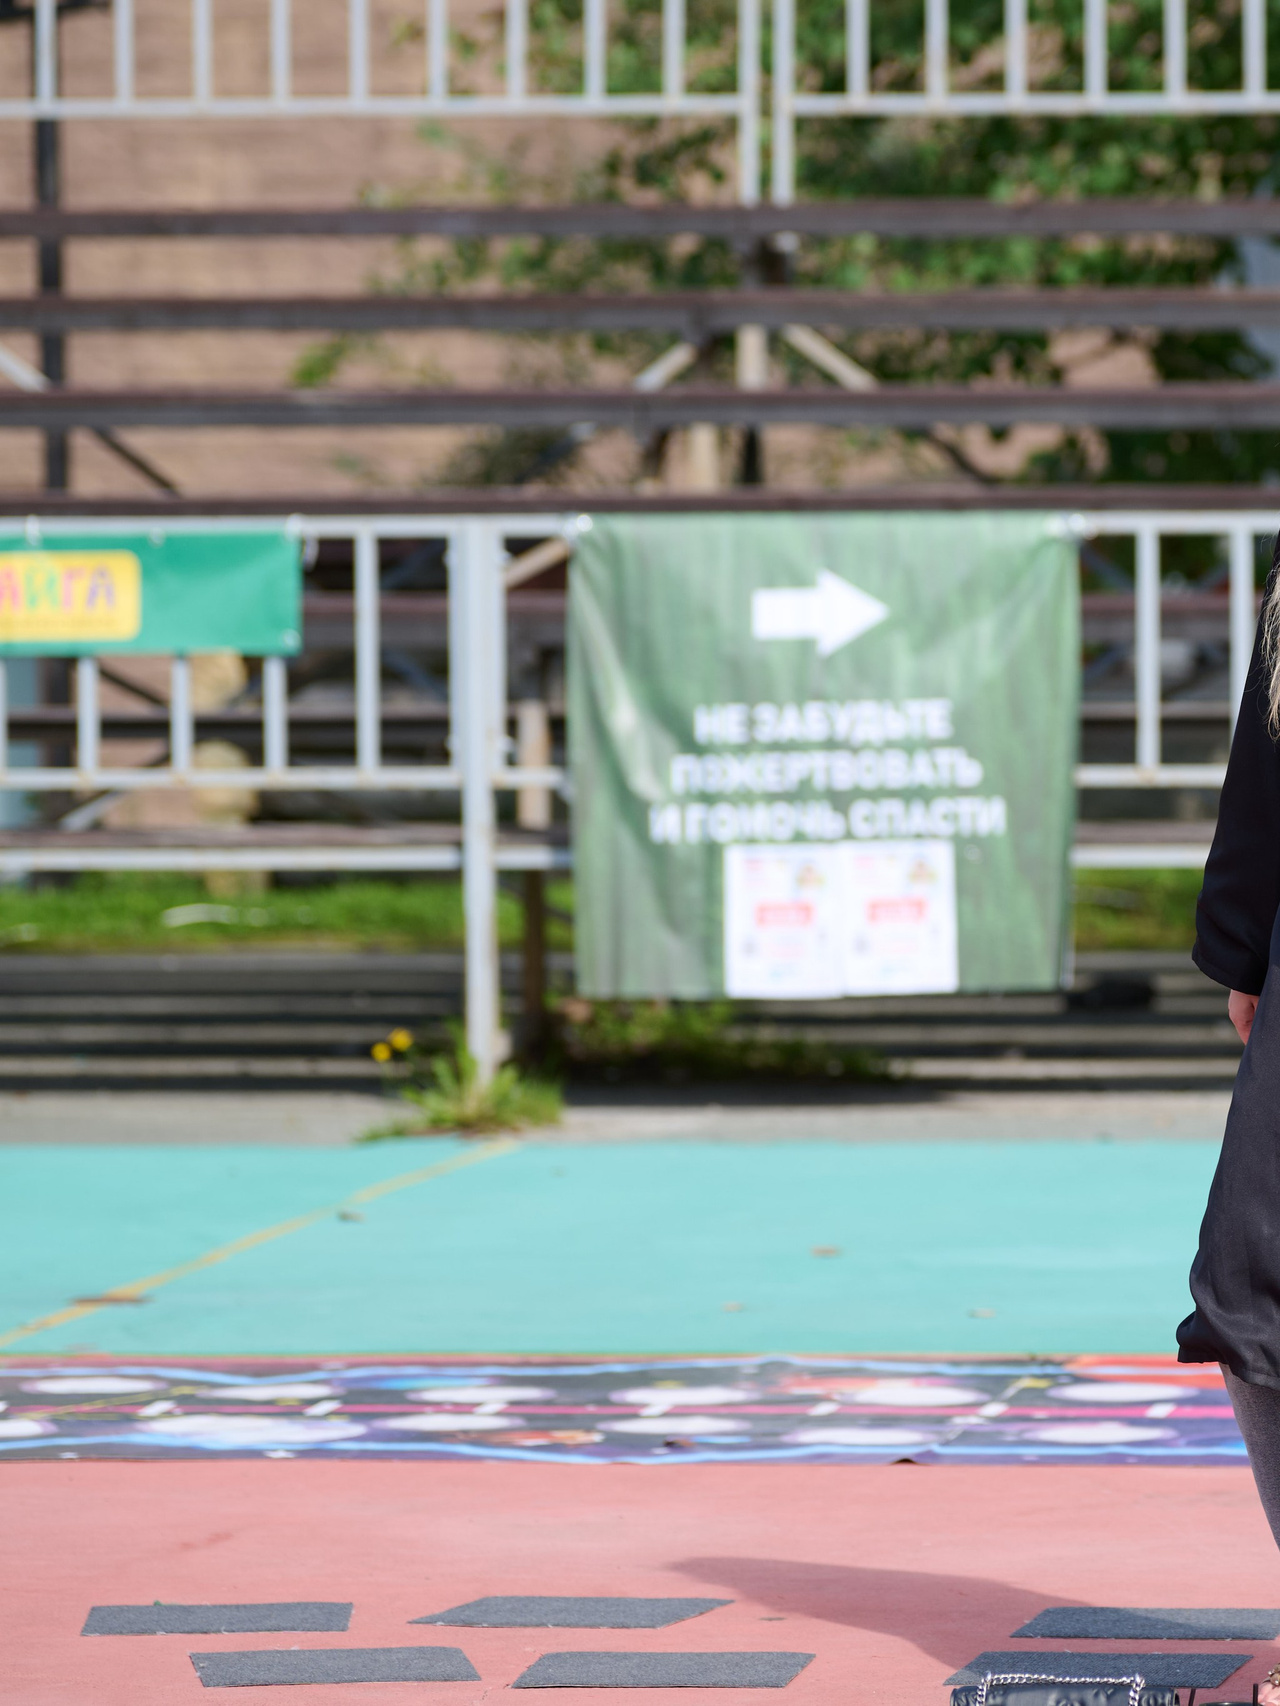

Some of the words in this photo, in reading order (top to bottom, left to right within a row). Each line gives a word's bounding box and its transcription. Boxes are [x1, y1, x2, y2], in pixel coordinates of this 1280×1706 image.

[693, 702, 750, 745] НЕ
[752, 697, 954, 747] ЗАБУДЬТЕ
[670, 746, 984, 795] ПОЖЕРТВОВАТЬ
[648, 802, 682, 845] И
[848, 794, 1008, 840] СПАСТИ
